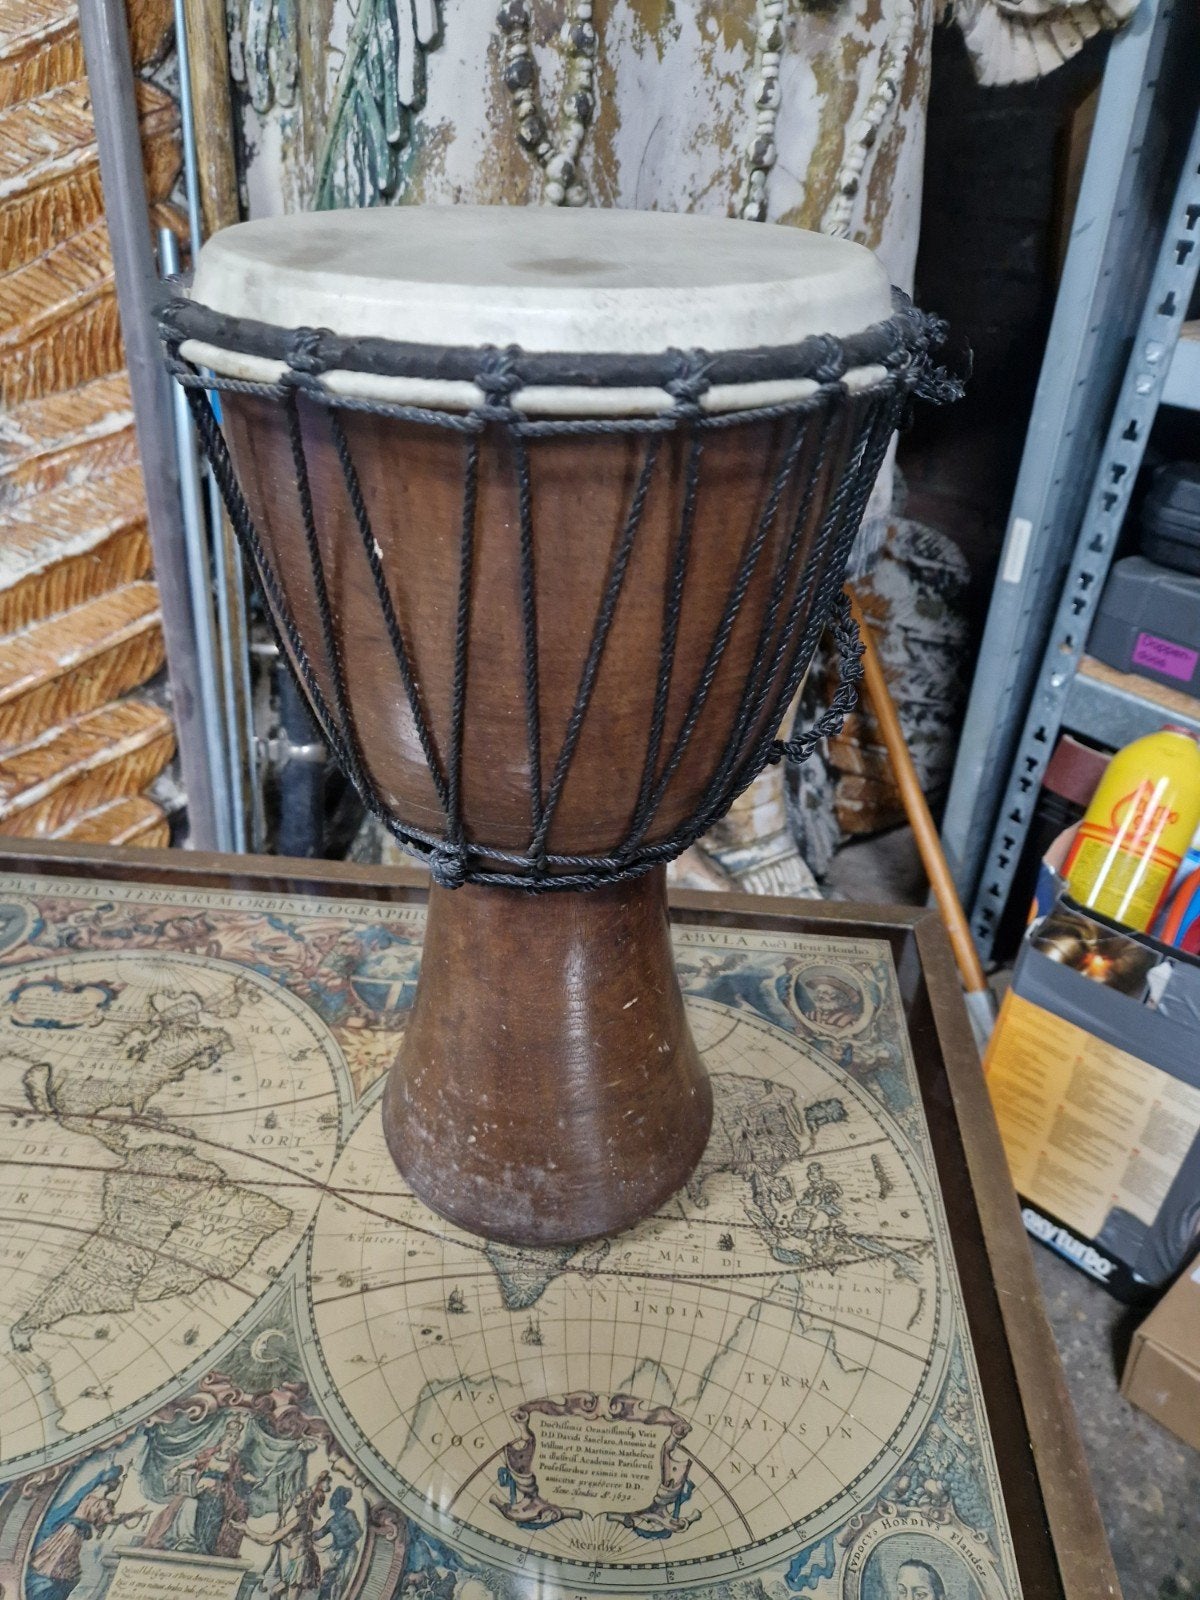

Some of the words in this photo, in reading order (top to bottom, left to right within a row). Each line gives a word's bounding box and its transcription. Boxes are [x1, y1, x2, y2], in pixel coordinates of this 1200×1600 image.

[238, 898, 294, 911] ORBIS
[250, 1024, 291, 1035] MAR
[260, 1078, 306, 1090] DEL
[247, 1134, 305, 1147] NORT
[22, 1144, 69, 1157] DEL
[659, 1250, 700, 1264] MAR
[722, 1258, 741, 1268] DI
[634, 1301, 704, 1318] INDIA
[744, 1372, 830, 1391] TERRA
[453, 1390, 495, 1404] AVS
[704, 1413, 807, 1435] TRALIS
[826, 1426, 852, 1439] IN
[649, 1440, 656, 1448] de
[580, 1456, 615, 1466] Academia
[730, 1461, 798, 1480] NITA
[569, 1538, 623, 1553] Meridies
[881, 1517, 941, 1532] HONDIVS
[950, 1531, 988, 1578] Flander
